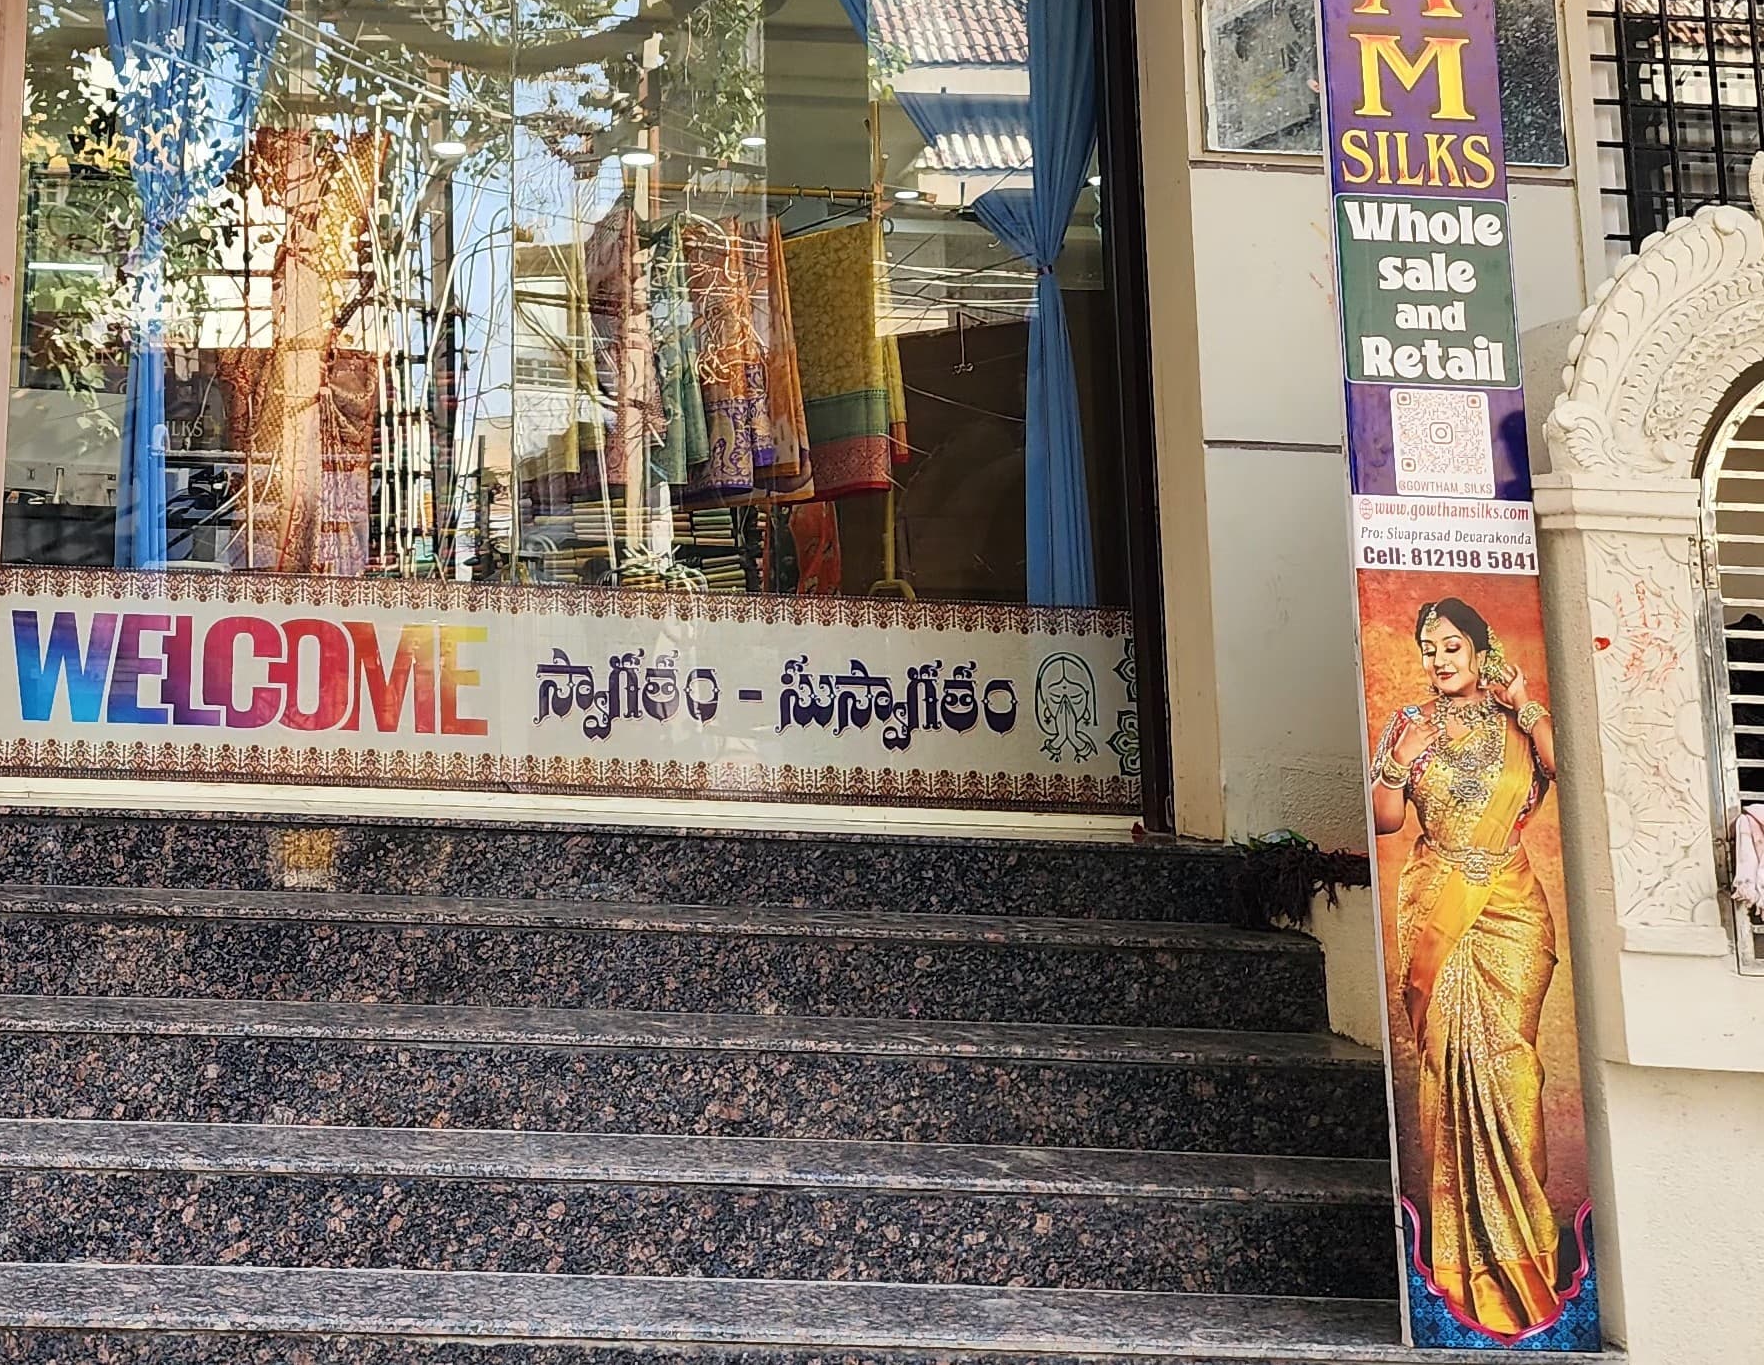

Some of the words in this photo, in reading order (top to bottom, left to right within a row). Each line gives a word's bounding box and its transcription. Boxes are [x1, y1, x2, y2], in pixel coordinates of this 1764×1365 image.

[1340, 129, 1497, 189] SILKS
[1345, 201, 1504, 248] Whole
[1378, 254, 1477, 294] sale
[1395, 299, 1467, 333] and
[1360, 336, 1506, 383] Retail
[1398, 479, 1493, 495] @GOWTHAM_SILKS
[1374, 501, 1529, 521] www.gowthamsilks.com
[1361, 526, 1384, 539] Pro:
[1387, 526, 1451, 545] Sivaprasad
[1454, 529, 1532, 545] Devarakonda
[1363, 545, 1407, 566] Cell:
[1411, 547, 1482, 569] 812198
[1487, 550, 1536, 571] 5841
[10, 609, 489, 736] WELCOME
[533, 647, 720, 741] స్వాగతం
[774, 654, 1020, 753] సుస్వాగతం
